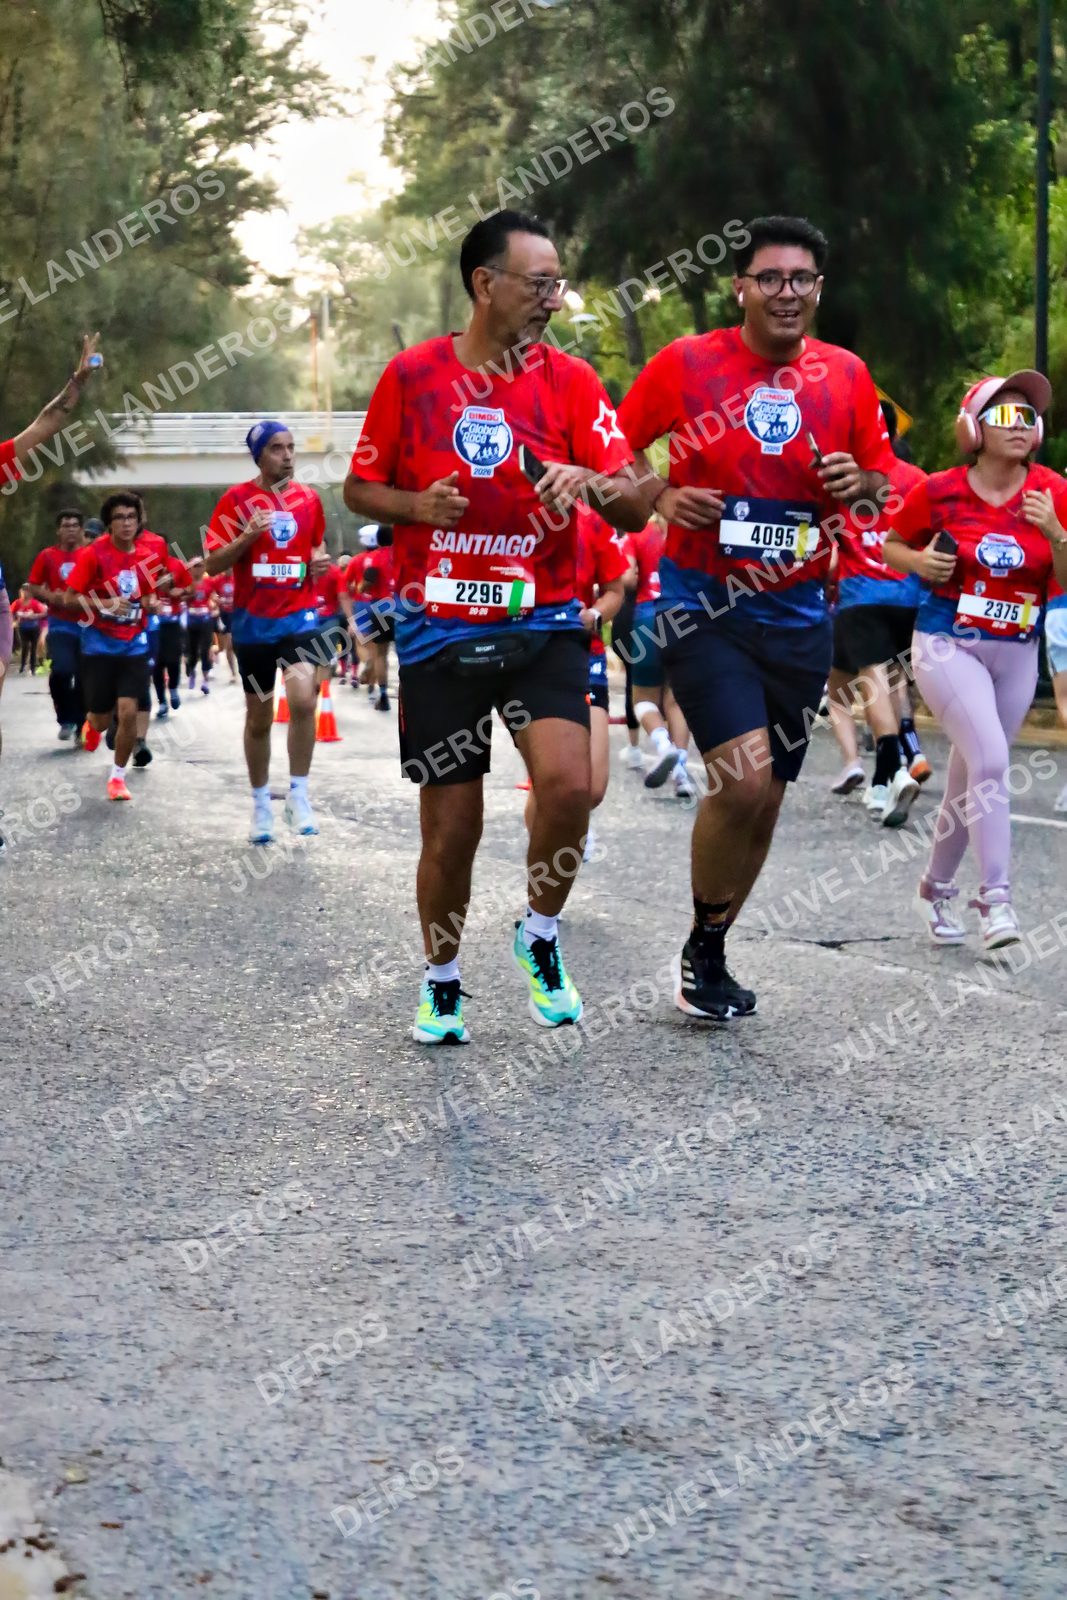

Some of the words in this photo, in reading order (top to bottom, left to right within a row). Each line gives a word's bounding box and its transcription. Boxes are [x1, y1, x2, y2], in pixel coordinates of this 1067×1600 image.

[462, 431, 488, 444] Race
[469, 422, 498, 436] Global
[430, 528, 537, 558] SANTIAGO
[751, 525, 795, 547] 4095
[271, 564, 293, 576] 3104
[456, 582, 503, 605] 2296
[984, 599, 1021, 621] 2375
